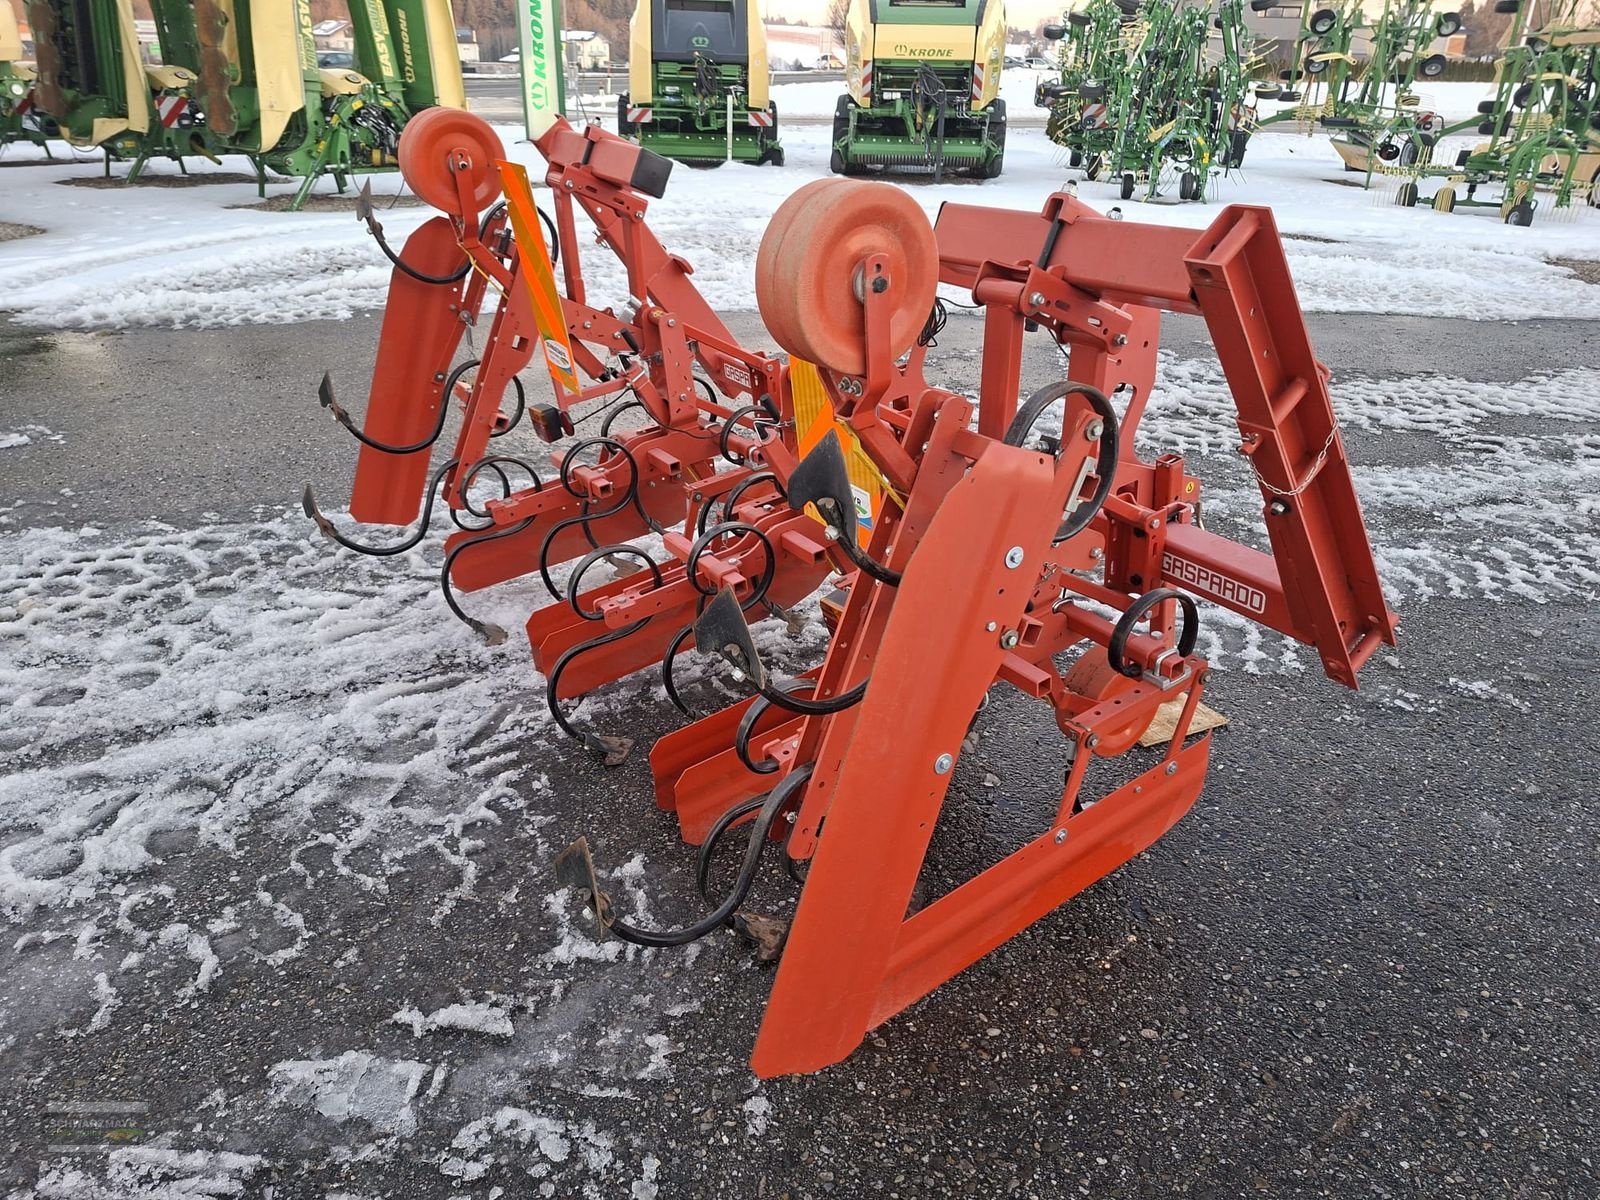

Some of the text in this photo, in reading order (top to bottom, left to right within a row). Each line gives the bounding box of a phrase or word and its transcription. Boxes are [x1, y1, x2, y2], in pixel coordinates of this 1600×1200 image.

[397, 8, 413, 68] KRONE
[908, 48, 954, 58] KRONE
[1161, 552, 1264, 612] GASPARDO
